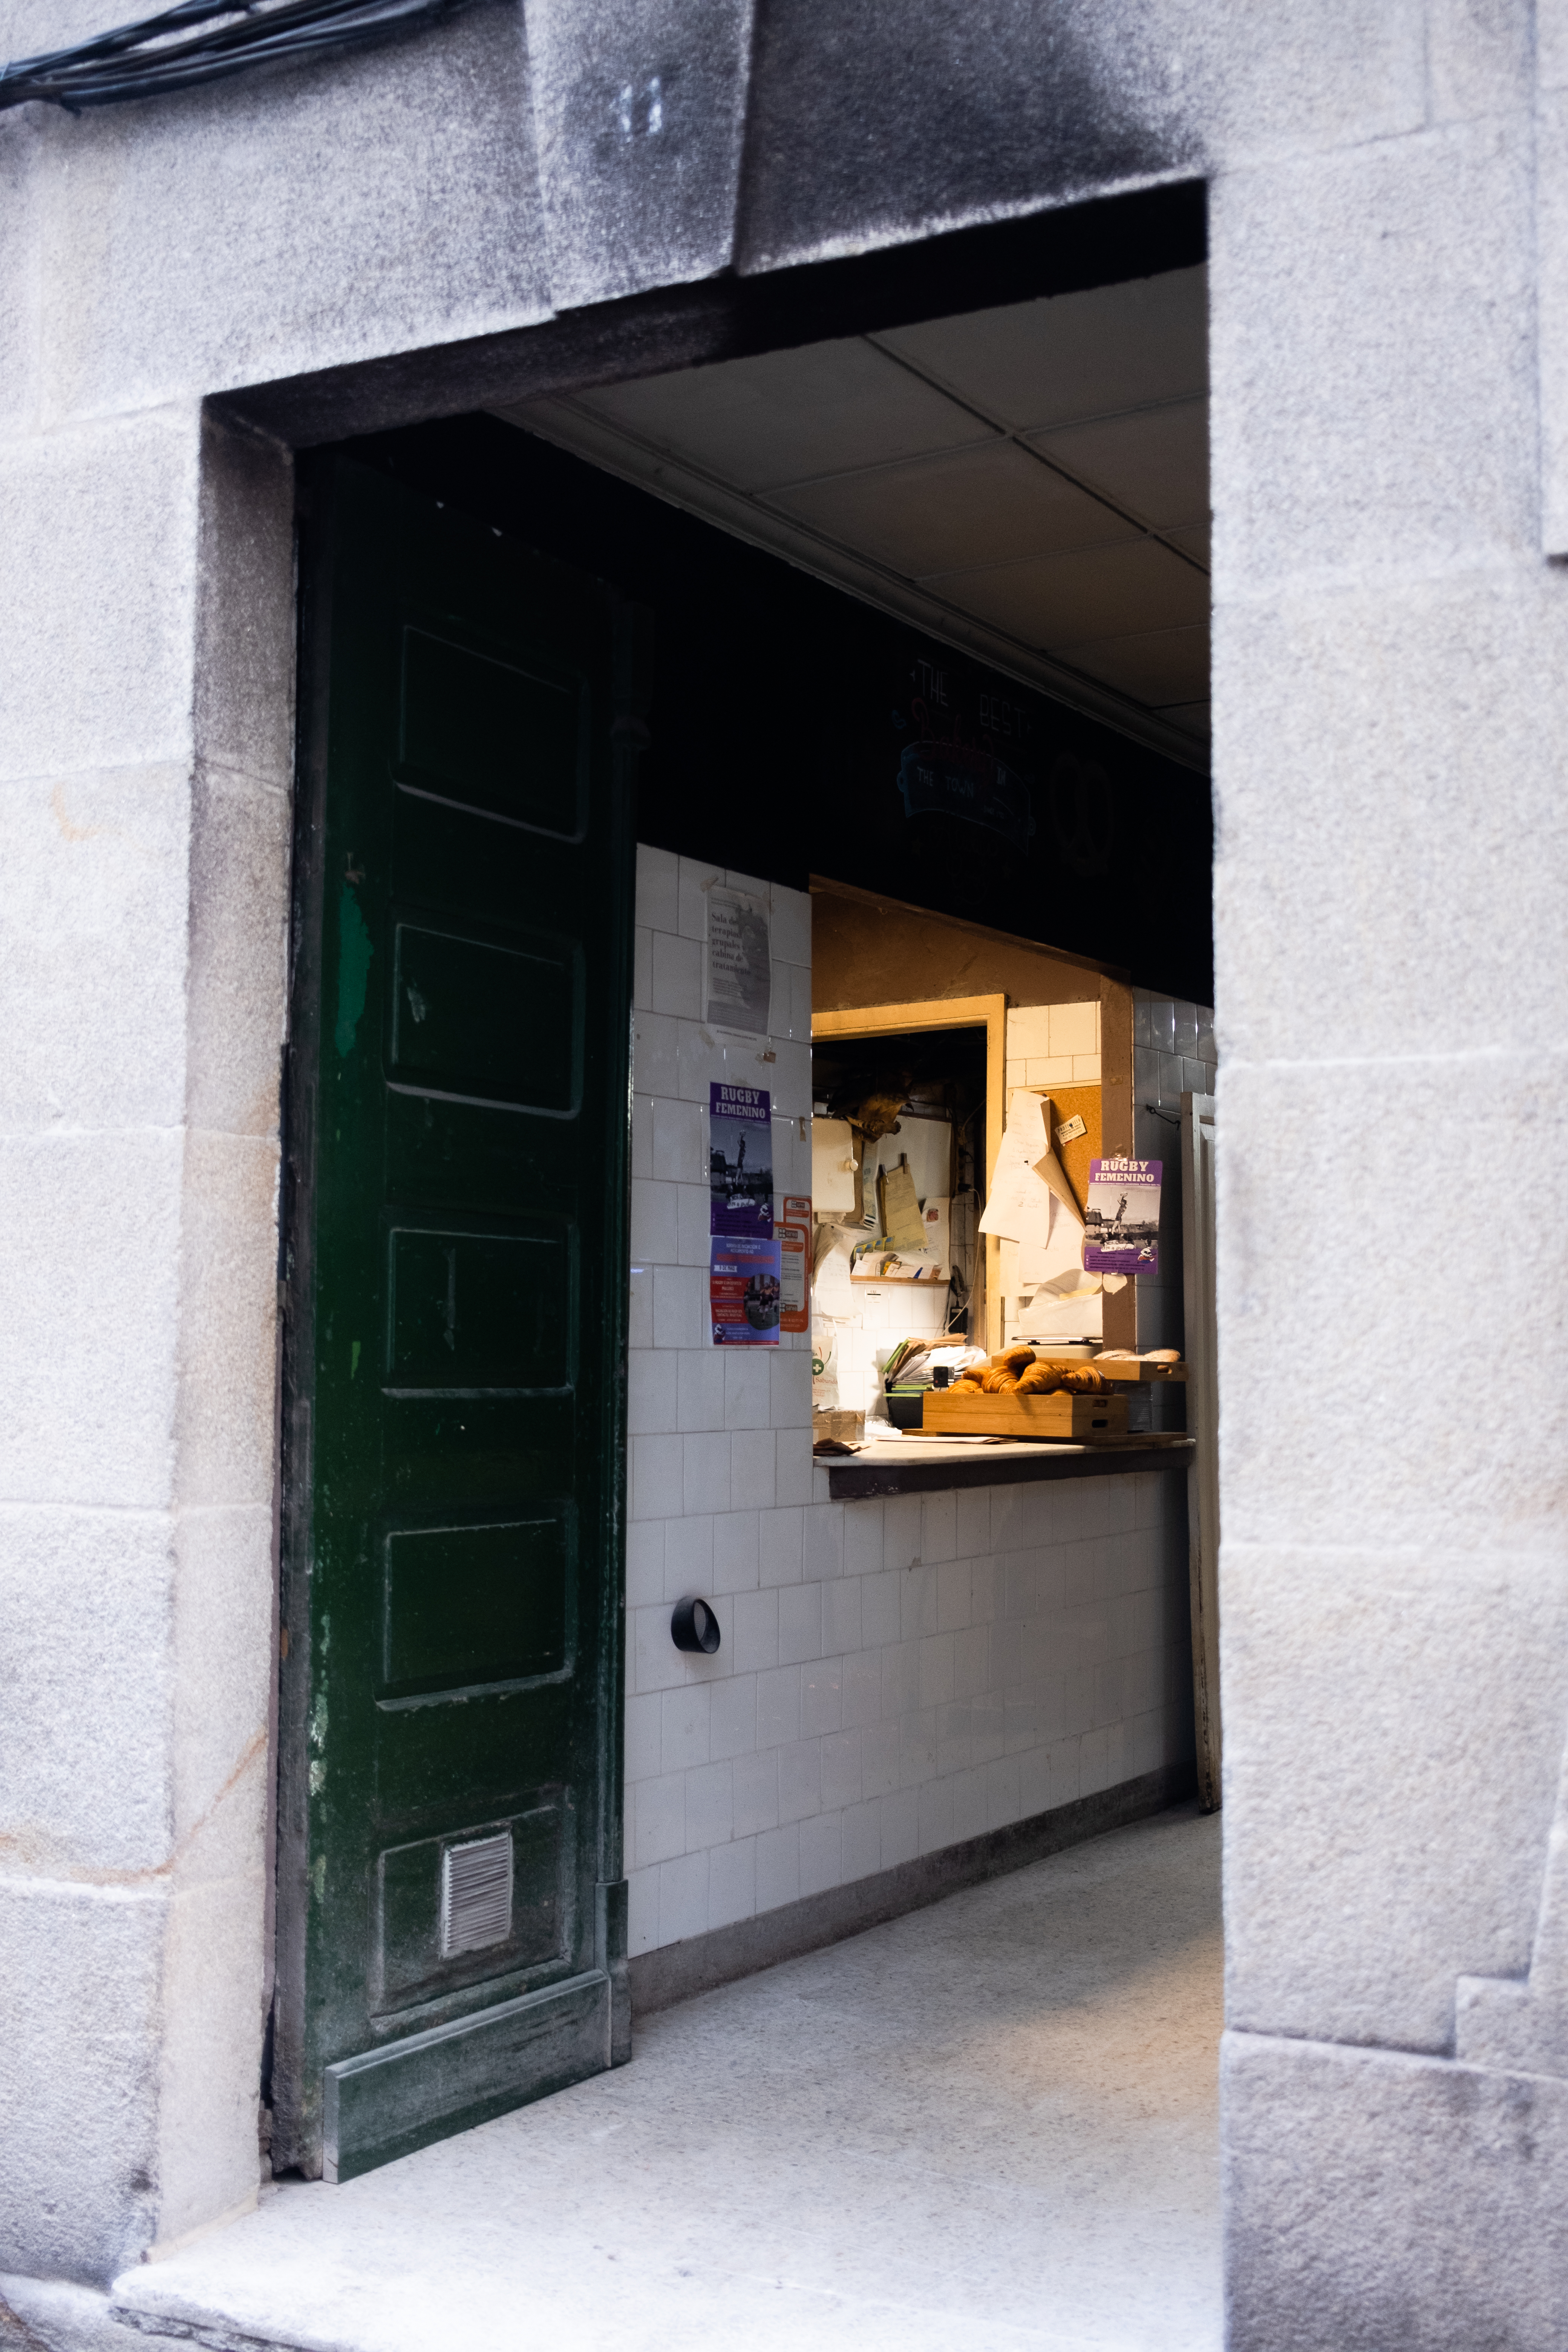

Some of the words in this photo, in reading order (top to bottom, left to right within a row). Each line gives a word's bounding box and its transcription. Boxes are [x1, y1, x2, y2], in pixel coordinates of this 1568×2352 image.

[917, 659, 948, 707] THE
[980, 694, 1025, 738] BEST
[917, 766, 933, 786] THE
[945, 775, 974, 798] TOWN
[712, 912, 727, 925] Sala
[712, 937, 740, 952] grupales
[712, 949, 734, 961] cabina
[712, 960, 750, 975] tratamiento
[721, 1086, 760, 1105] RUGBY
[715, 1102, 766, 1119] FEMENINO
[1100, 1160, 1149, 1172] RUGBY
[1095, 1173, 1154, 1182] FEMENINO
